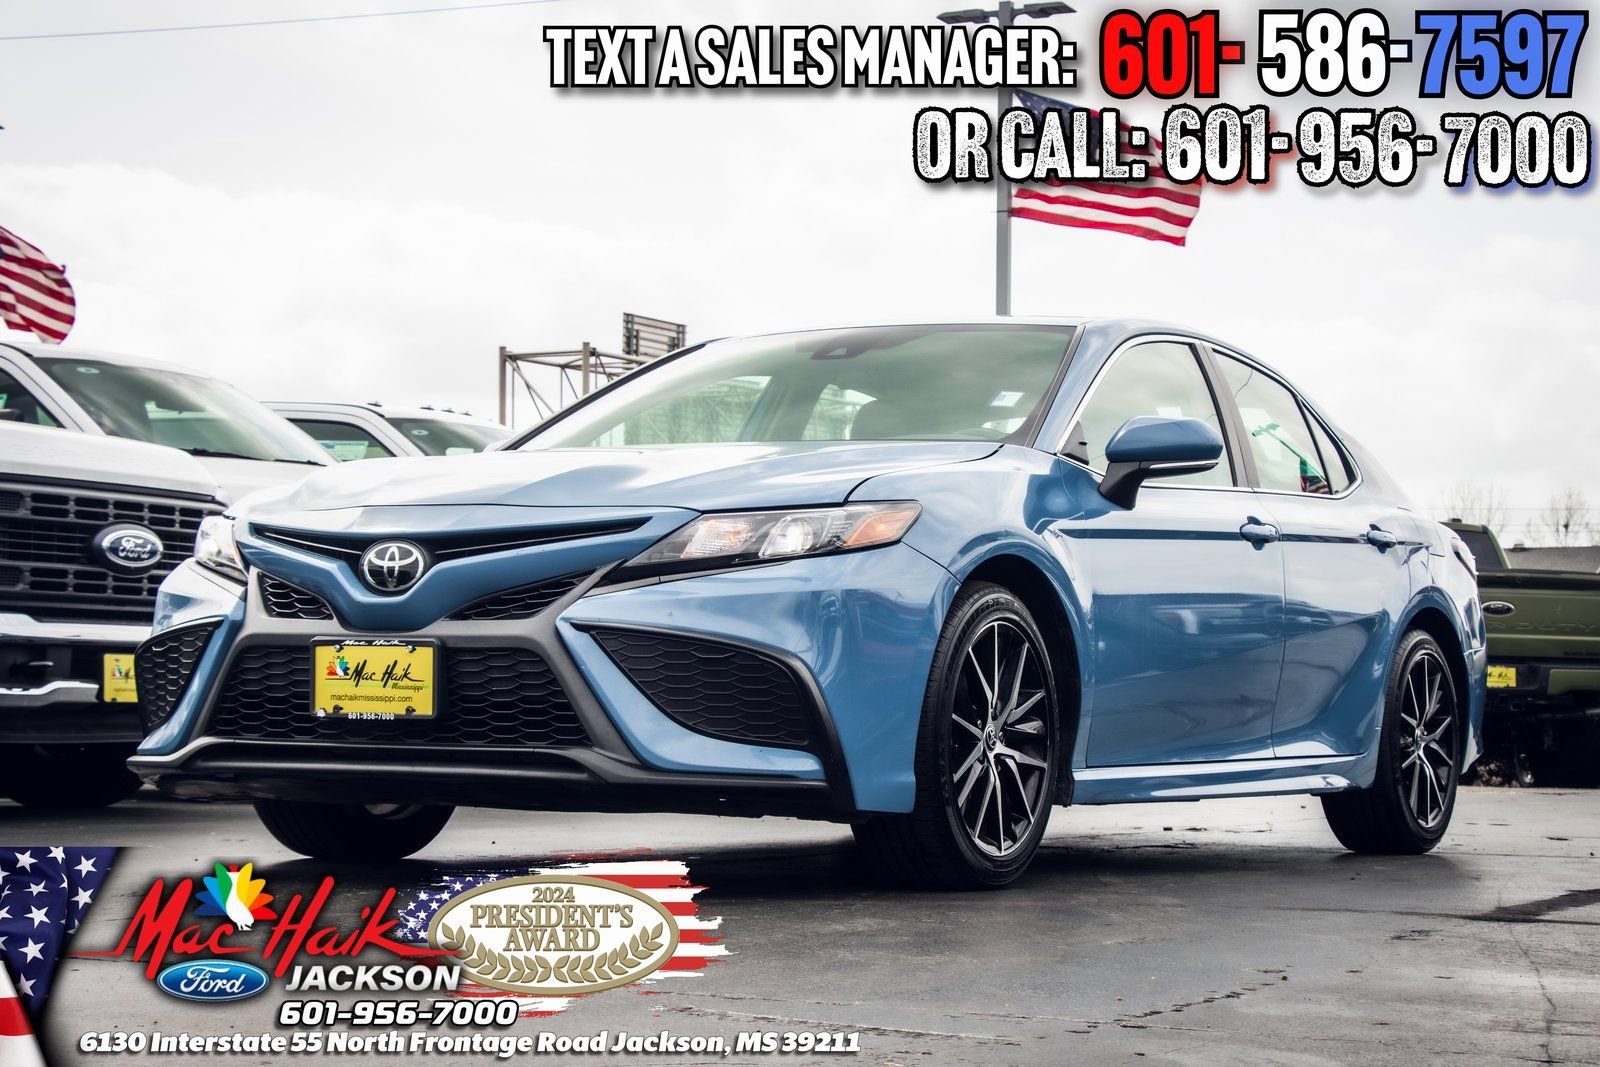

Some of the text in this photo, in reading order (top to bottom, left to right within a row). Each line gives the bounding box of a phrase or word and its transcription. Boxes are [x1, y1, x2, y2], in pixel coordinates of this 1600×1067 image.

[118, 536, 152, 559] Ford
[349, 659, 423, 688] Mac Haik
[391, 682, 424, 693] Mississippi
[330, 693, 413, 704] machaikmississippi.com
[348, 712, 395, 721] 601-956-7000
